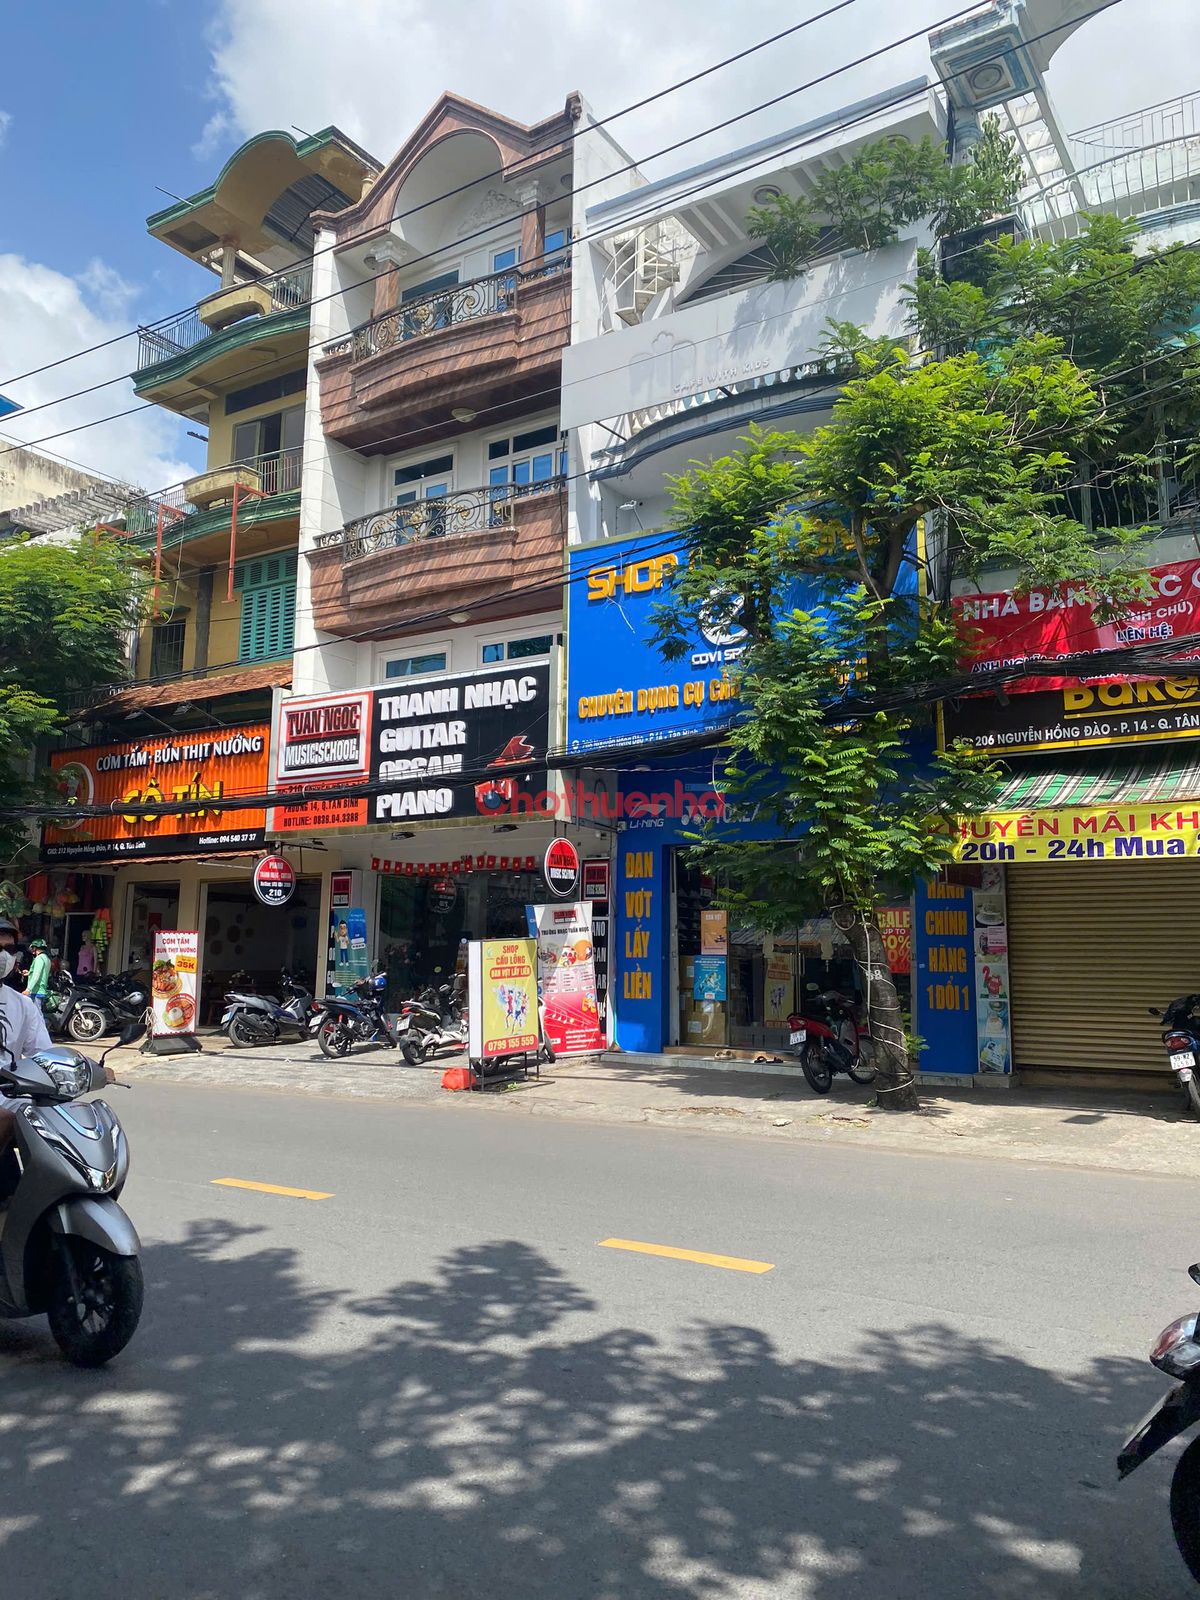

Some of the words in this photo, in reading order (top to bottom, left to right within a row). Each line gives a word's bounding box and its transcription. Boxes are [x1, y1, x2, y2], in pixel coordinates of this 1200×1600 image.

[588, 553, 679, 600] SHOP
[963, 589, 1020, 621] NHÀ
[1149, 621, 1174, 640] HỆ:
[378, 687, 459, 721] THANH
[464, 676, 537, 710] NHẠC
[578, 688, 634, 718] CHUYÊN
[637, 684, 679, 714] DỤNG
[683, 681, 705, 707] CỤ
[379, 720, 466, 753] GUITAR
[975, 735, 995, 746] 206
[997, 727, 1042, 745] NGUYỄN
[1045, 723, 1080, 740] HỒNG
[1083, 721, 1111, 737] ĐÀO
[1120, 720, 1131, 734] P.
[1133, 719, 1148, 731] 14
[1158, 717, 1173, 730] Q.
[96, 756, 122, 772] CƠM
[123, 747, 147, 768] TẤM
[153, 743, 180, 763] BÚN
[183, 743, 213, 762] THỊT
[212, 734, 261, 756] NƯỚNG
[285, 743, 319, 766] MUSIC
[319, 738, 358, 763] SCHOOL
[375, 787, 453, 819] PIANO
[283, 815, 312, 827] HOTLINE:
[629, 818, 665, 829] LI-NING
[1073, 810, 1136, 835] MÃI
[961, 841, 1015, 861] 20h
[1047, 839, 1105, 859] 24h
[1114, 836, 1185, 857] Mua
[625, 887, 653, 923] VỢT
[925, 907, 968, 936] CHÍNH
[502, 944, 519, 954] SHOP
[625, 924, 650, 959] LẤY
[177, 960, 195, 970] 35K
[928, 945, 967, 973] HÃNG
[623, 962, 652, 999] LIỀN
[487, 1041, 507, 1052] 0799
[508, 1037, 520, 1049] 155
[521, 1035, 535, 1047] 559
